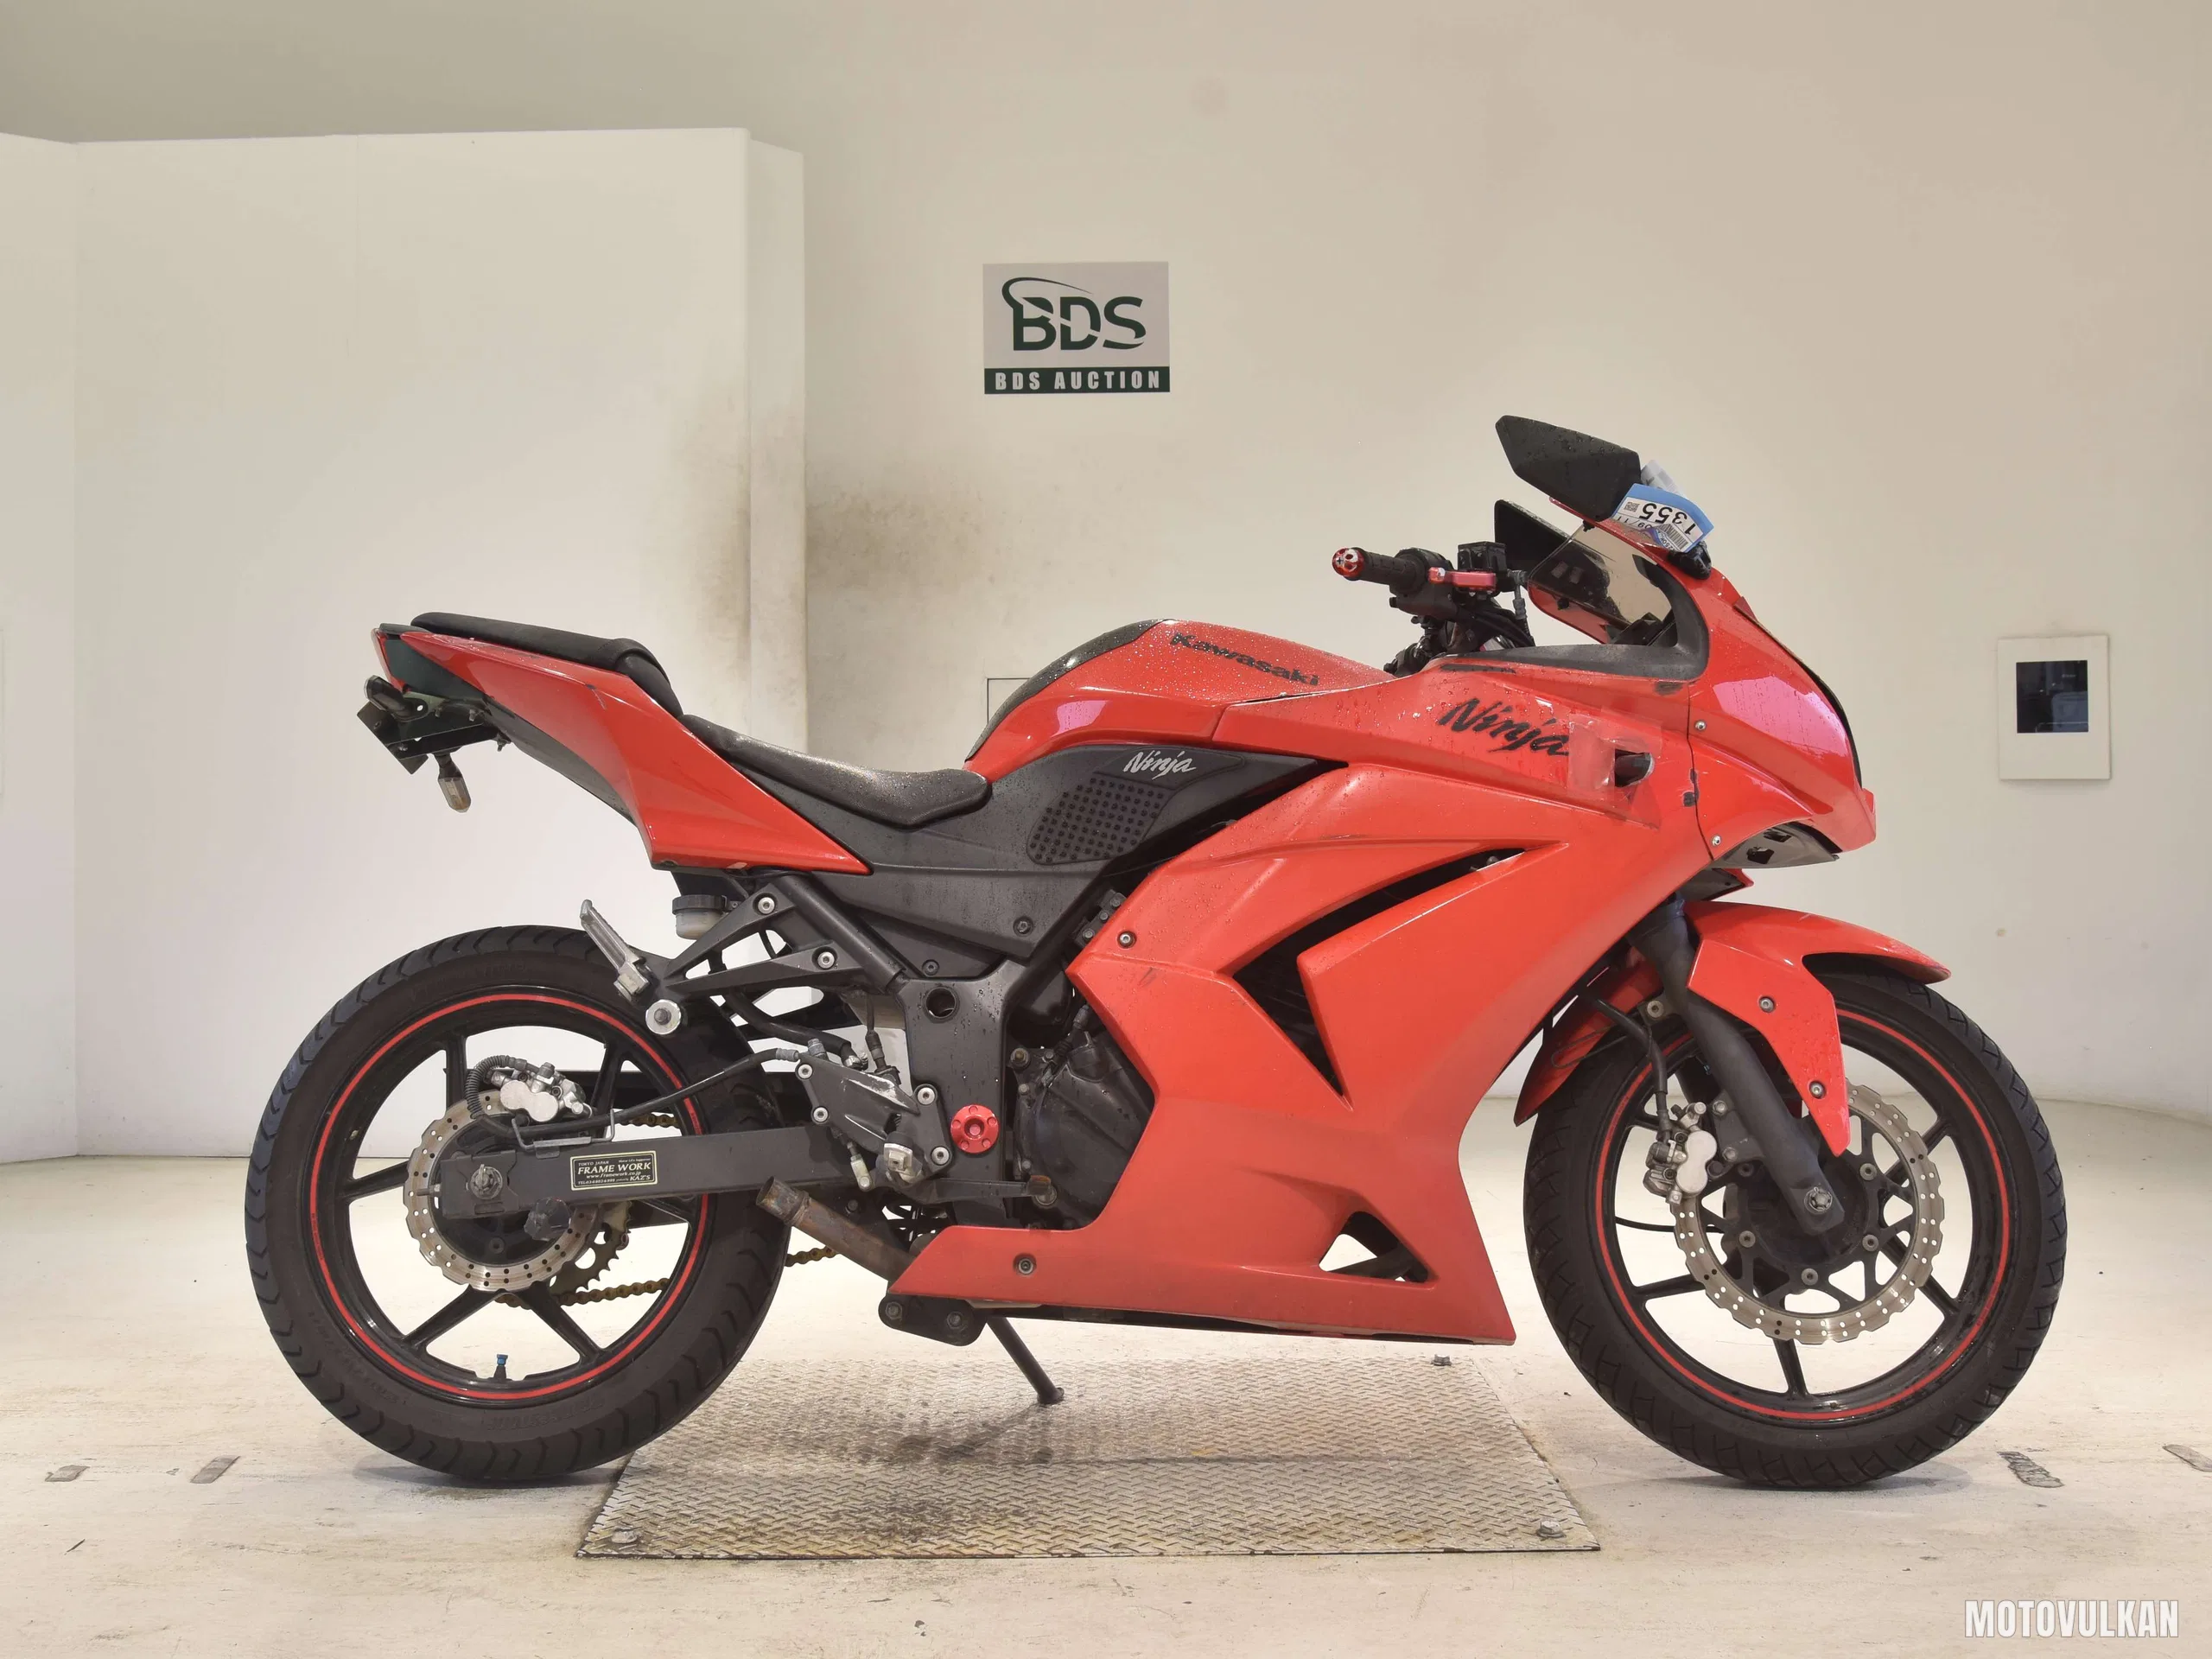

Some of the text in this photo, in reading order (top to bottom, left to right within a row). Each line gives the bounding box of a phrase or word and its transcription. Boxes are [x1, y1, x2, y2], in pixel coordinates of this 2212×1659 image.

[1001, 276, 1147, 351] BDS
[995, 370, 1160, 391] BDS AUCTION
[1639, 503, 1696, 536] 1355
[1169, 632, 1321, 686] Kawasaki
[1437, 697, 1570, 756] Ninja
[1123, 749, 1197, 780] Ninja
[577, 1161, 652, 1175] FRAME WORK
